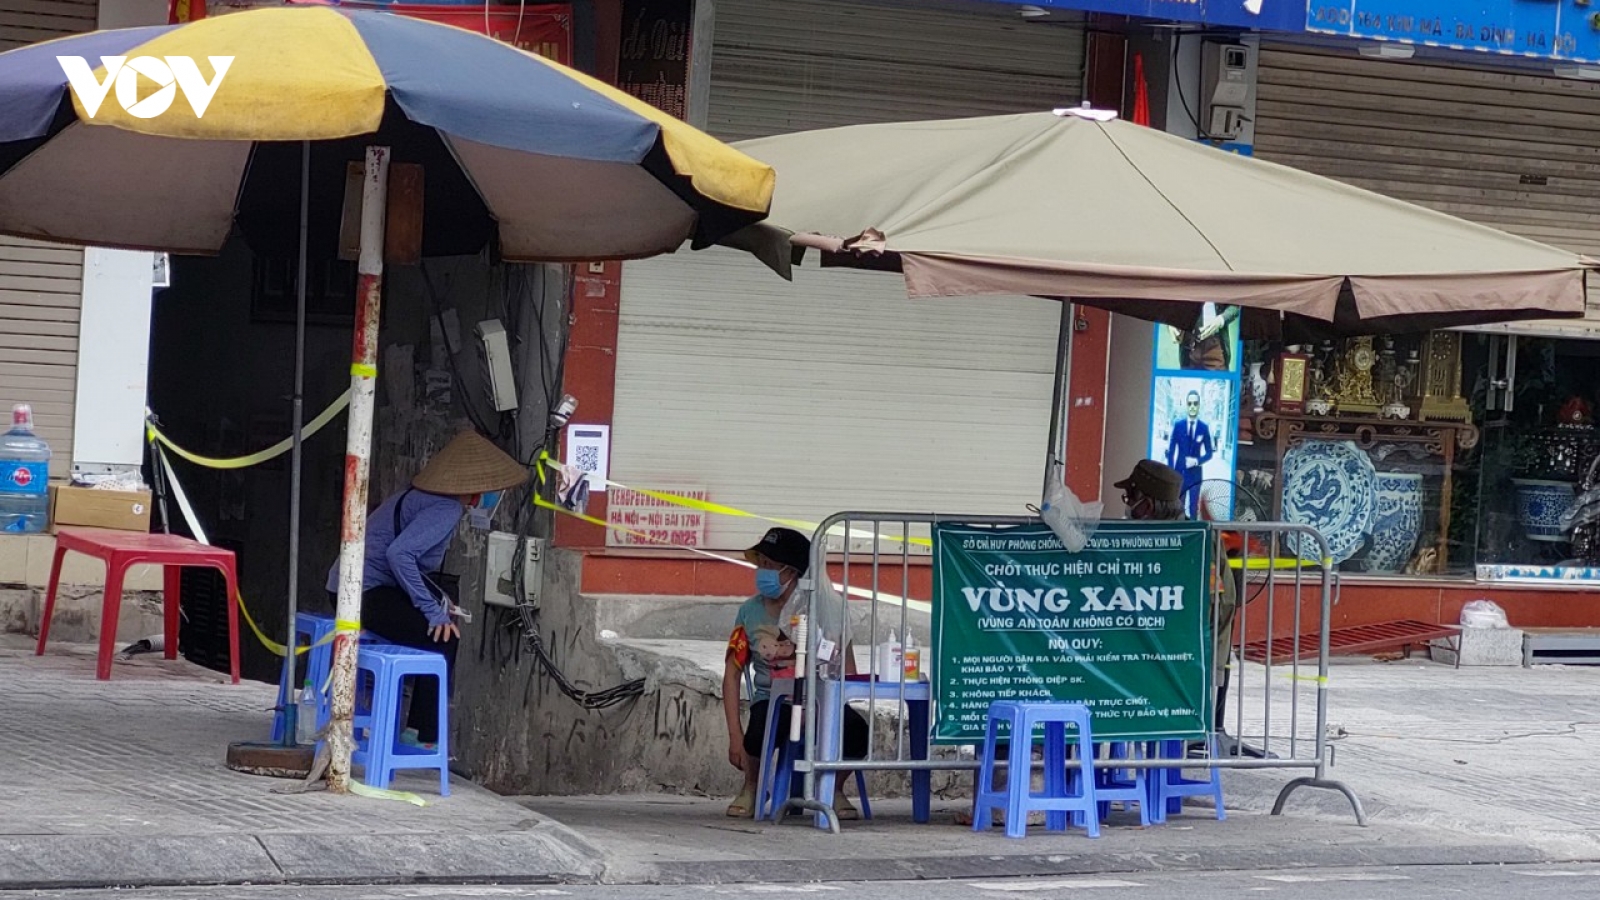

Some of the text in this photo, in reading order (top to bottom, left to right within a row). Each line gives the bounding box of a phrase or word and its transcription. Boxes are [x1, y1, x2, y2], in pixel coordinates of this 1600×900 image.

[1358, 11, 1381, 29] 164
[1387, 15, 1413, 32] KIM
[1455, 23, 1475, 40] BA
[611, 510, 622, 523] HÀ
[665, 510, 678, 526] BÀI
[990, 539, 1006, 550] HUY
[1008, 537, 1036, 550] PHÒNG
[1155, 537, 1168, 548] KIM
[984, 558, 1161, 579] CHỐT THỰC HIỆN CHỈ THỊ 16
[961, 581, 1184, 612] VÙNG XANH
[978, 615, 1014, 630] (VÙNG
[1017, 617, 1036, 629] AN
[1073, 614, 1113, 628] KHÔNG
[1116, 614, 1134, 627] CÓ
[1137, 615, 1165, 630] DỊCH)
[1048, 637, 1103, 653] NỘI QUY:
[963, 656, 981, 665] MỌI
[982, 654, 1013, 663] NGƯỜI
[1015, 654, 1033, 663] DÂN
[1096, 651, 1120, 662] KIỂM
[1122, 653, 1139, 661] TRA
[961, 665, 983, 673] KHAI
[985, 664, 1004, 673] BÁO
[962, 678, 988, 686] THỰC
[990, 675, 1010, 685] HIỆN
[1012, 675, 1044, 684] THÔNG
[962, 689, 995, 698] KHÔNG
[997, 688, 1016, 697] TIẾP
[1099, 699, 1123, 708] TRỰC
[1095, 709, 1120, 718] THỨC
[962, 723, 979, 731] GIA
